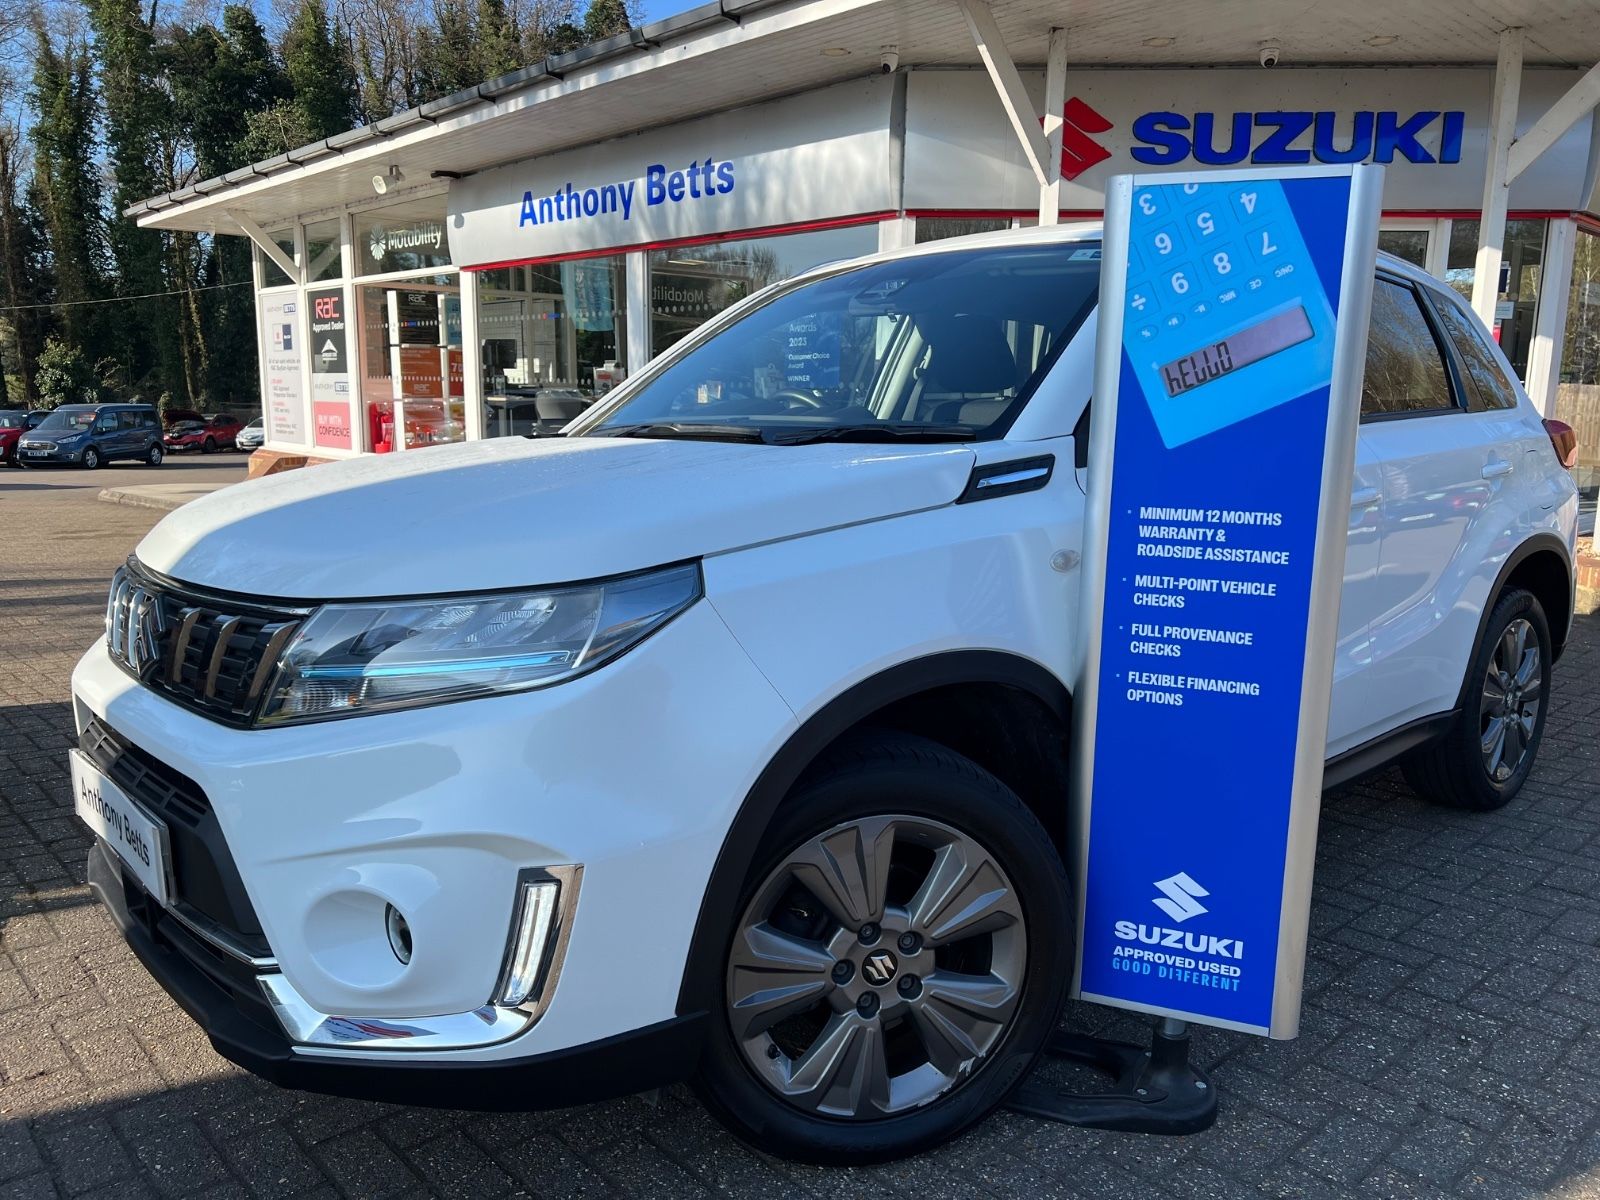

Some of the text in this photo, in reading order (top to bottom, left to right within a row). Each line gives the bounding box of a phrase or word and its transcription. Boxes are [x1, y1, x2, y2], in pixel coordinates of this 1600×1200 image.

[1130, 111, 1465, 165] SUZUKI
[519, 157, 735, 227] Anthony Betts
[1240, 192, 1257, 215] 4
[1138, 193, 1157, 215] 3
[1197, 212, 1215, 236] 5
[387, 221, 442, 251] Motability
[1154, 232, 1173, 255] 6
[1261, 231, 1278, 256] 7
[1213, 252, 1232, 275] 8
[1171, 272, 1190, 294] 9
[315, 296, 340, 319] RAC
[318, 426, 350, 438] CONFIDENCE
[1139, 506, 1283, 526] MINIMUM 12 MONTHS
[1138, 525, 1226, 542] WARRANTY &
[1137, 543, 1290, 565] ROADSIDE ASSISTANCE
[1134, 574, 1276, 596] MULTI-POINT VEHICLE
[1133, 592, 1185, 609] CHECKS
[1131, 623, 1253, 645] FULL PROVENANCE
[1130, 641, 1181, 657] CHECKS
[1128, 671, 1260, 696] FLEXIBLE FINANCING
[1126, 688, 1183, 706] OPTIONS
[81, 777, 150, 868] Anthony Betts
[1114, 920, 1244, 960] SUZUKI
[1113, 945, 1241, 978] APPROVED USED
[1112, 957, 1240, 992] GOOD DIFFERENT
